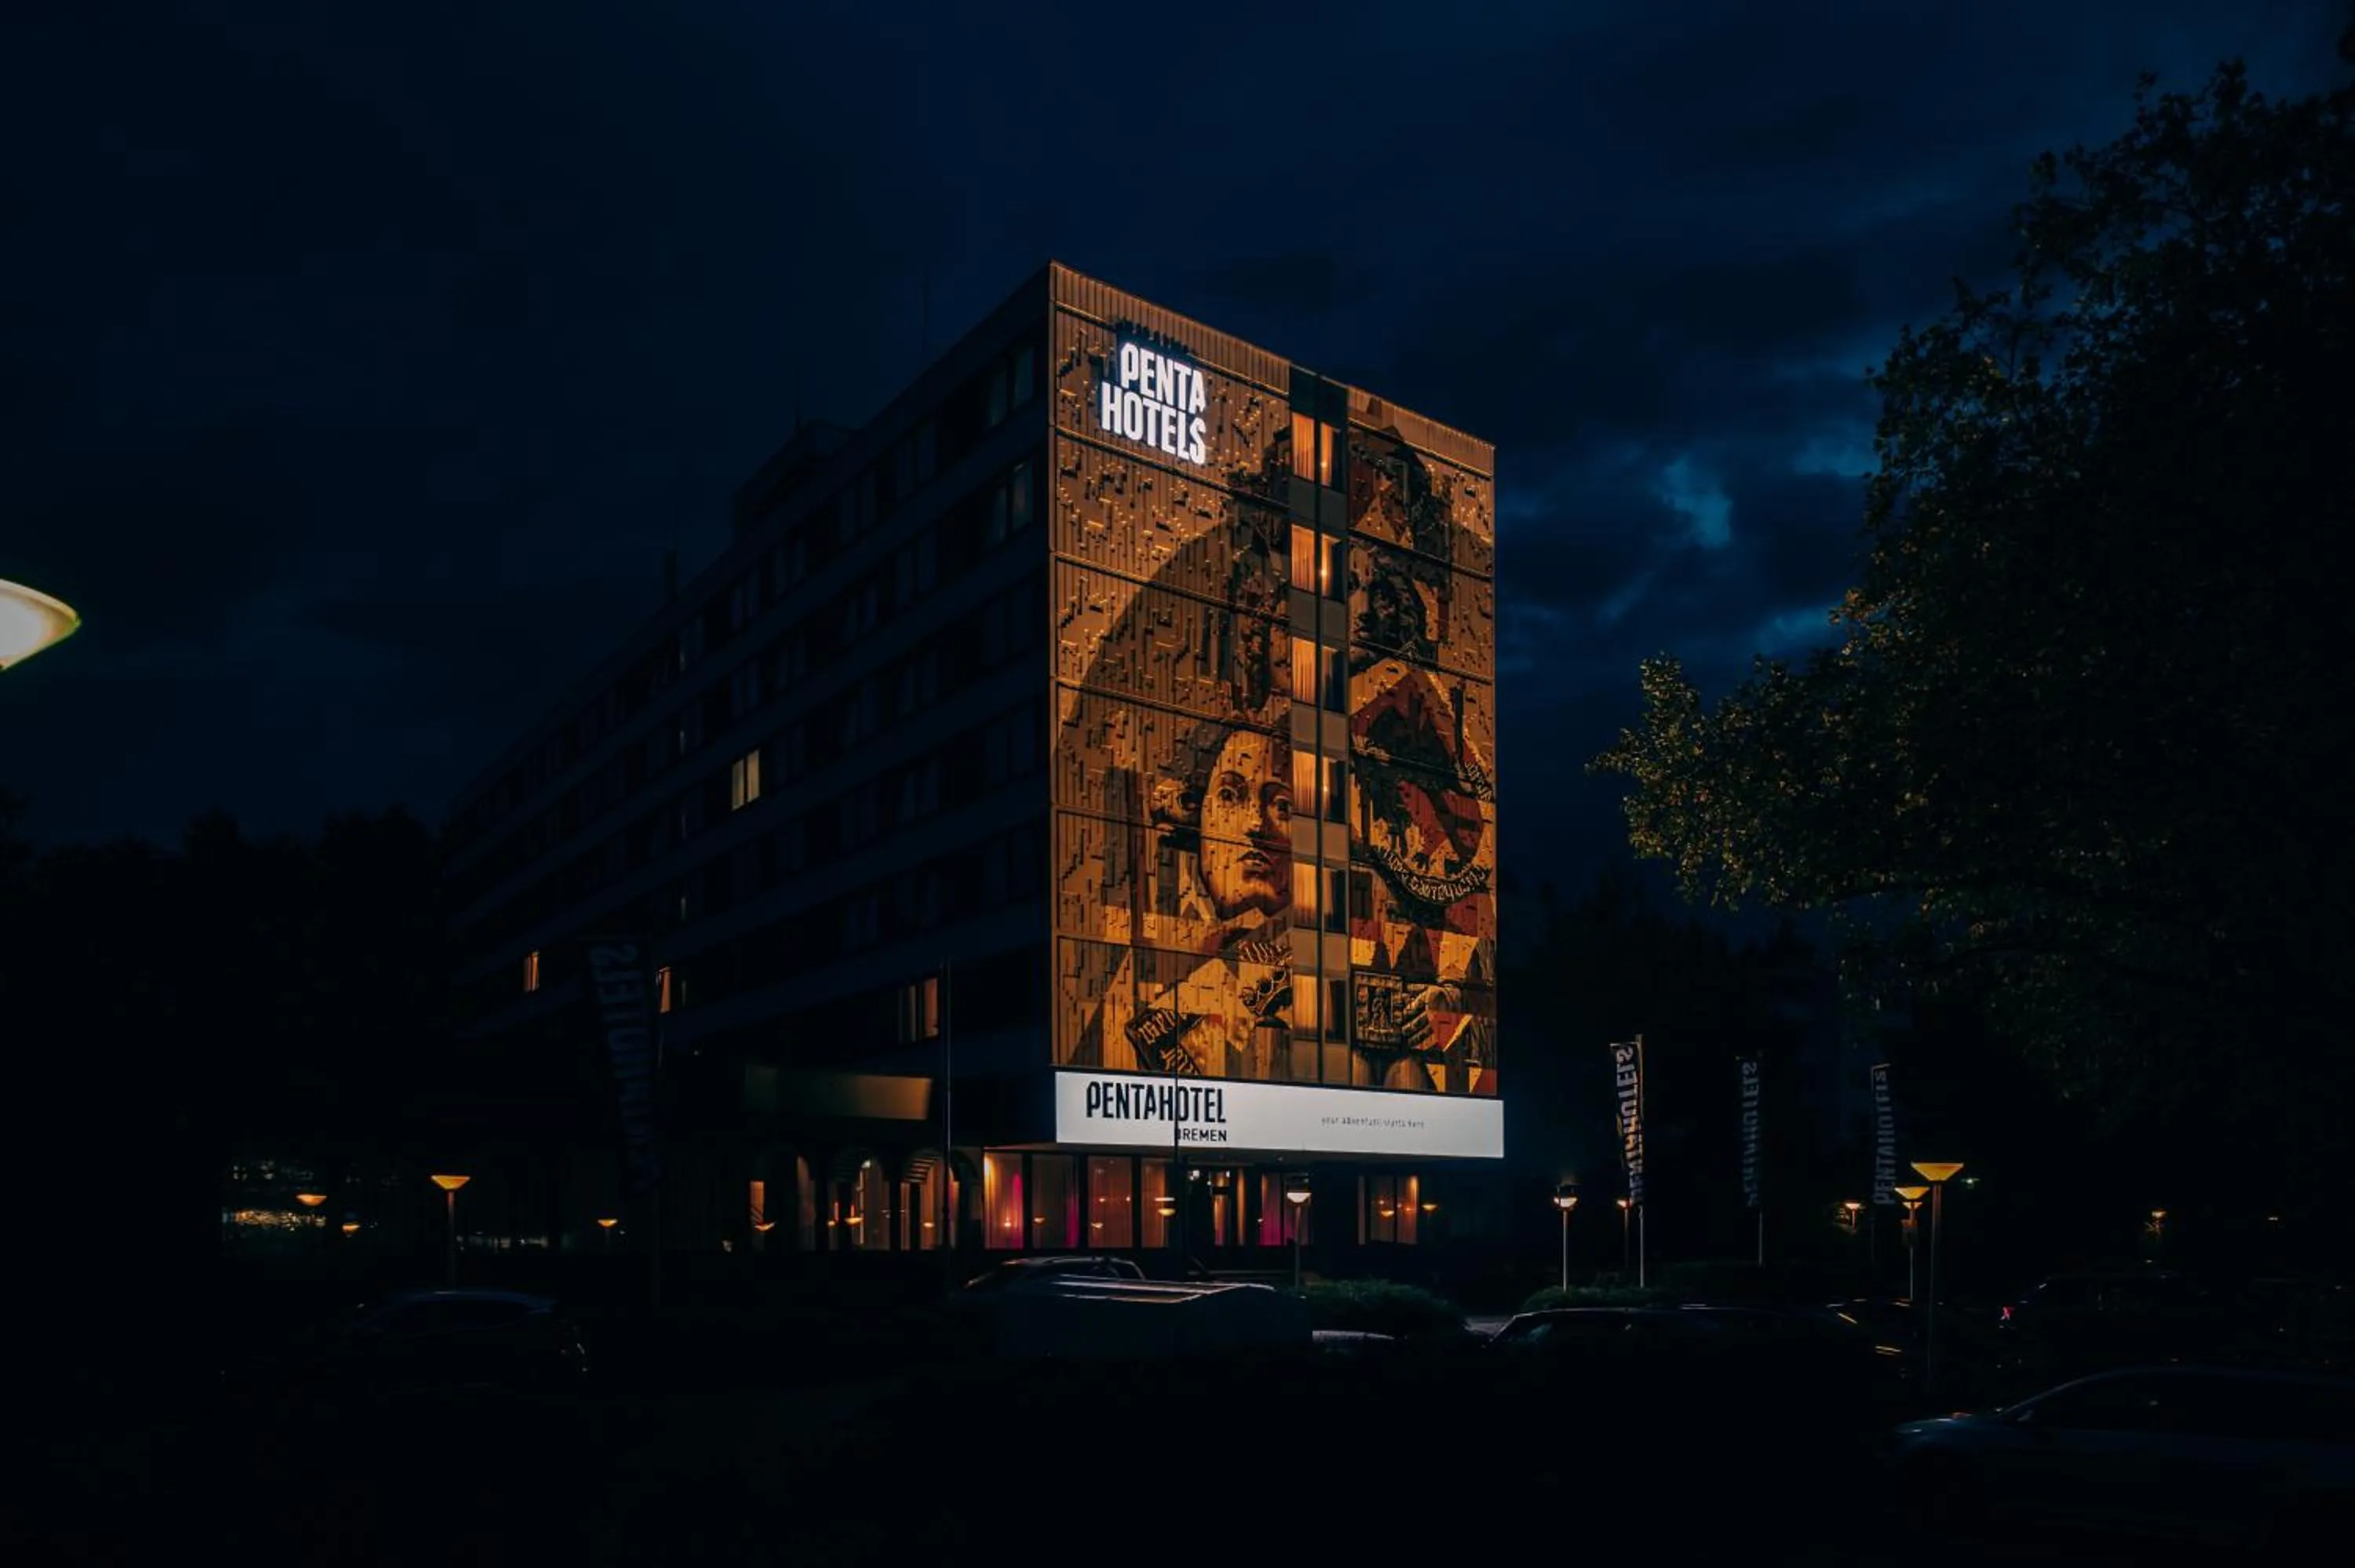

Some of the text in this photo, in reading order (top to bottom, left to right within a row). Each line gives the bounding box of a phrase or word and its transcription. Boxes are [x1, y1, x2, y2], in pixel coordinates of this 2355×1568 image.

[1120, 341, 1206, 414] PENTA
[1101, 381, 1207, 465] HOTELS
[1086, 1081, 1226, 1122] PENTAHOTEL
